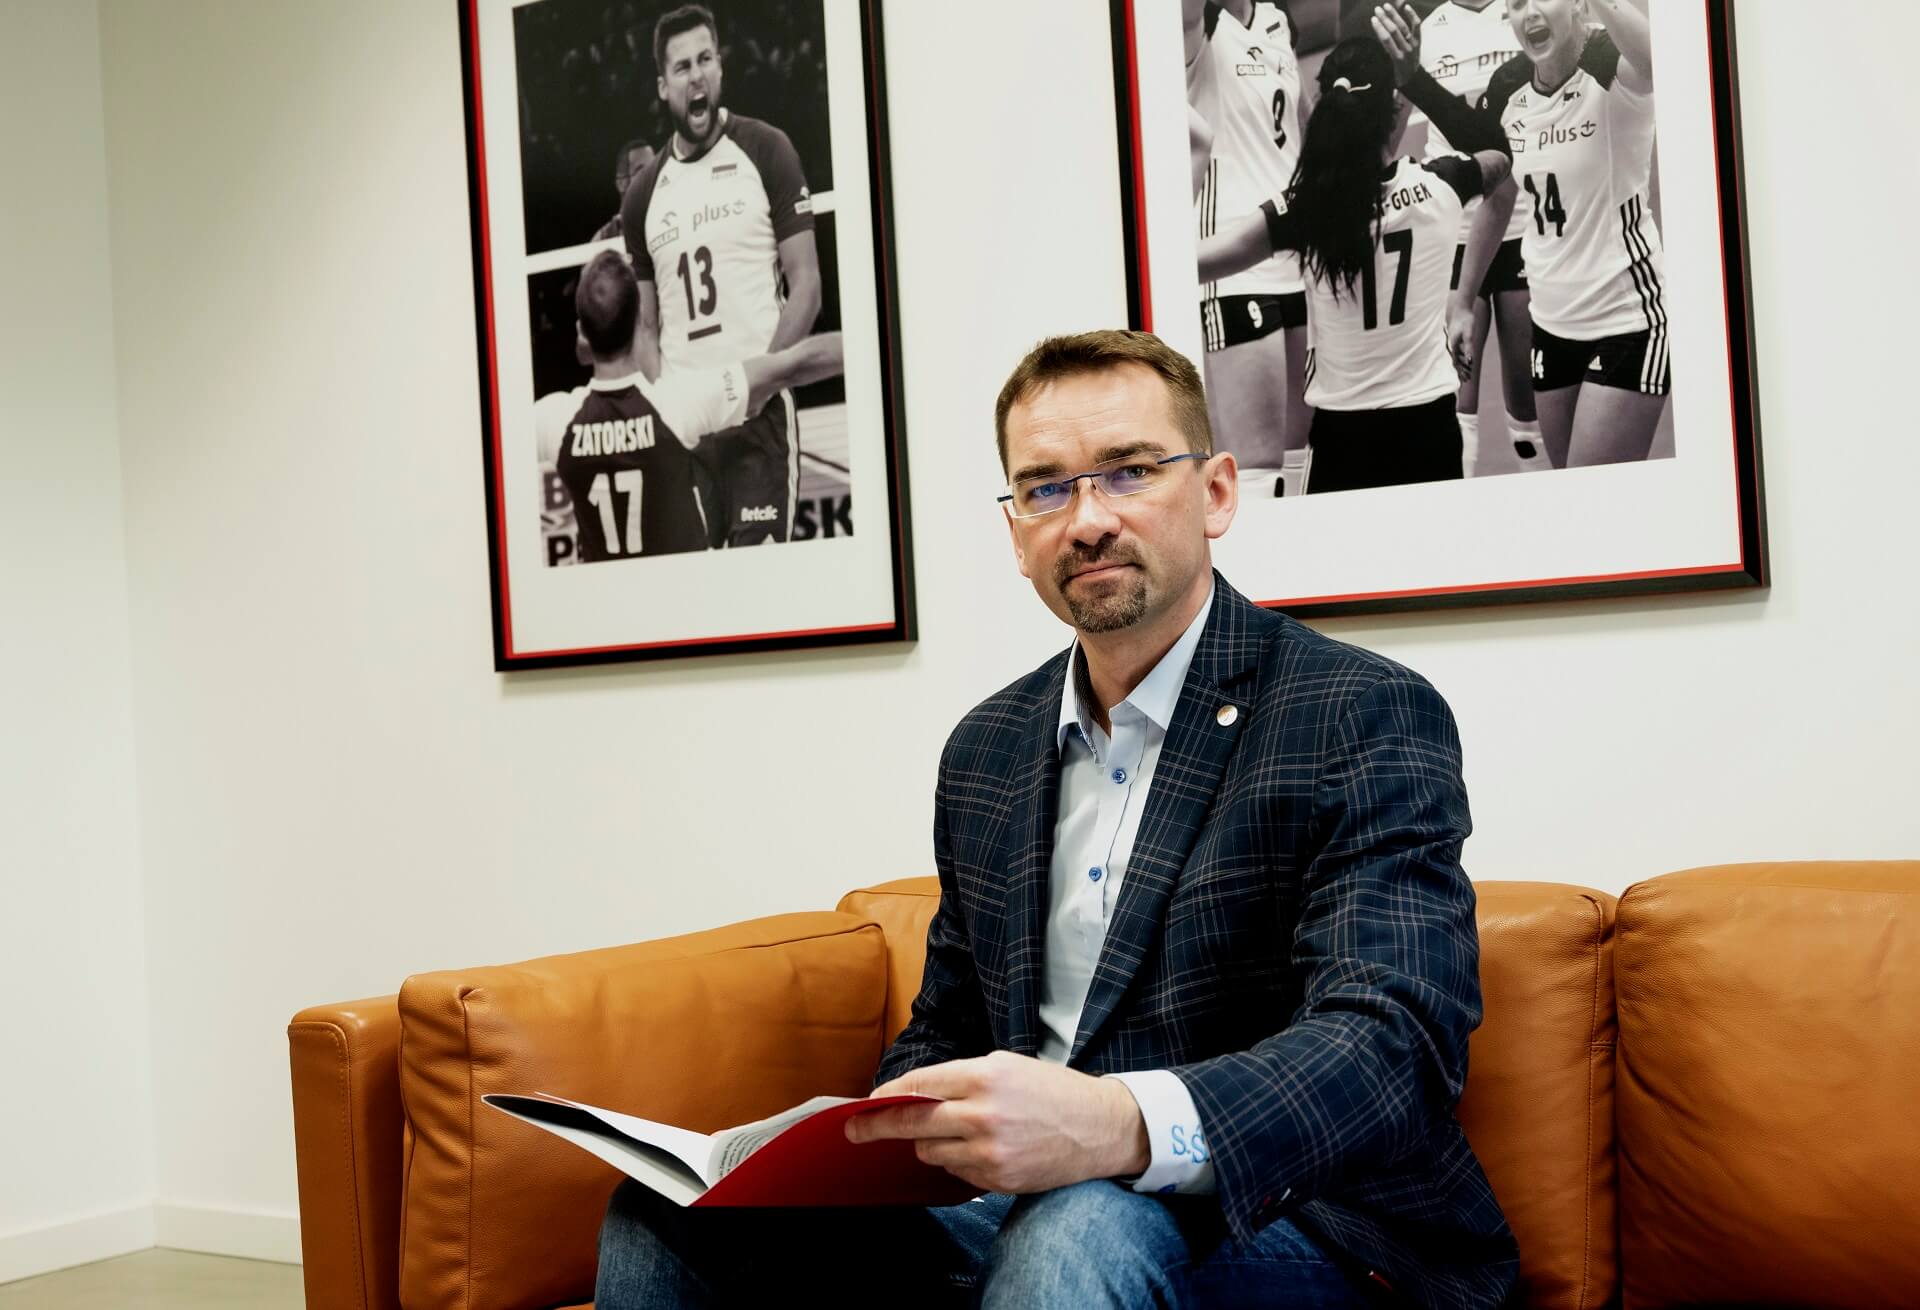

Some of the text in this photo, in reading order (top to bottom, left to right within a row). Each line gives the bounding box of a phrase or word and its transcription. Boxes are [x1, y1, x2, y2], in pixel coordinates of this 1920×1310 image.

[1538, 123, 1578, 151] plus
[692, 203, 731, 232] plus
[1524, 172, 1567, 237] 14
[677, 246, 717, 320] 13
[1361, 228, 1413, 331] 17
[1247, 300, 1263, 328] 9
[571, 414, 656, 457] ZATORSKI
[587, 469, 644, 554] 17
